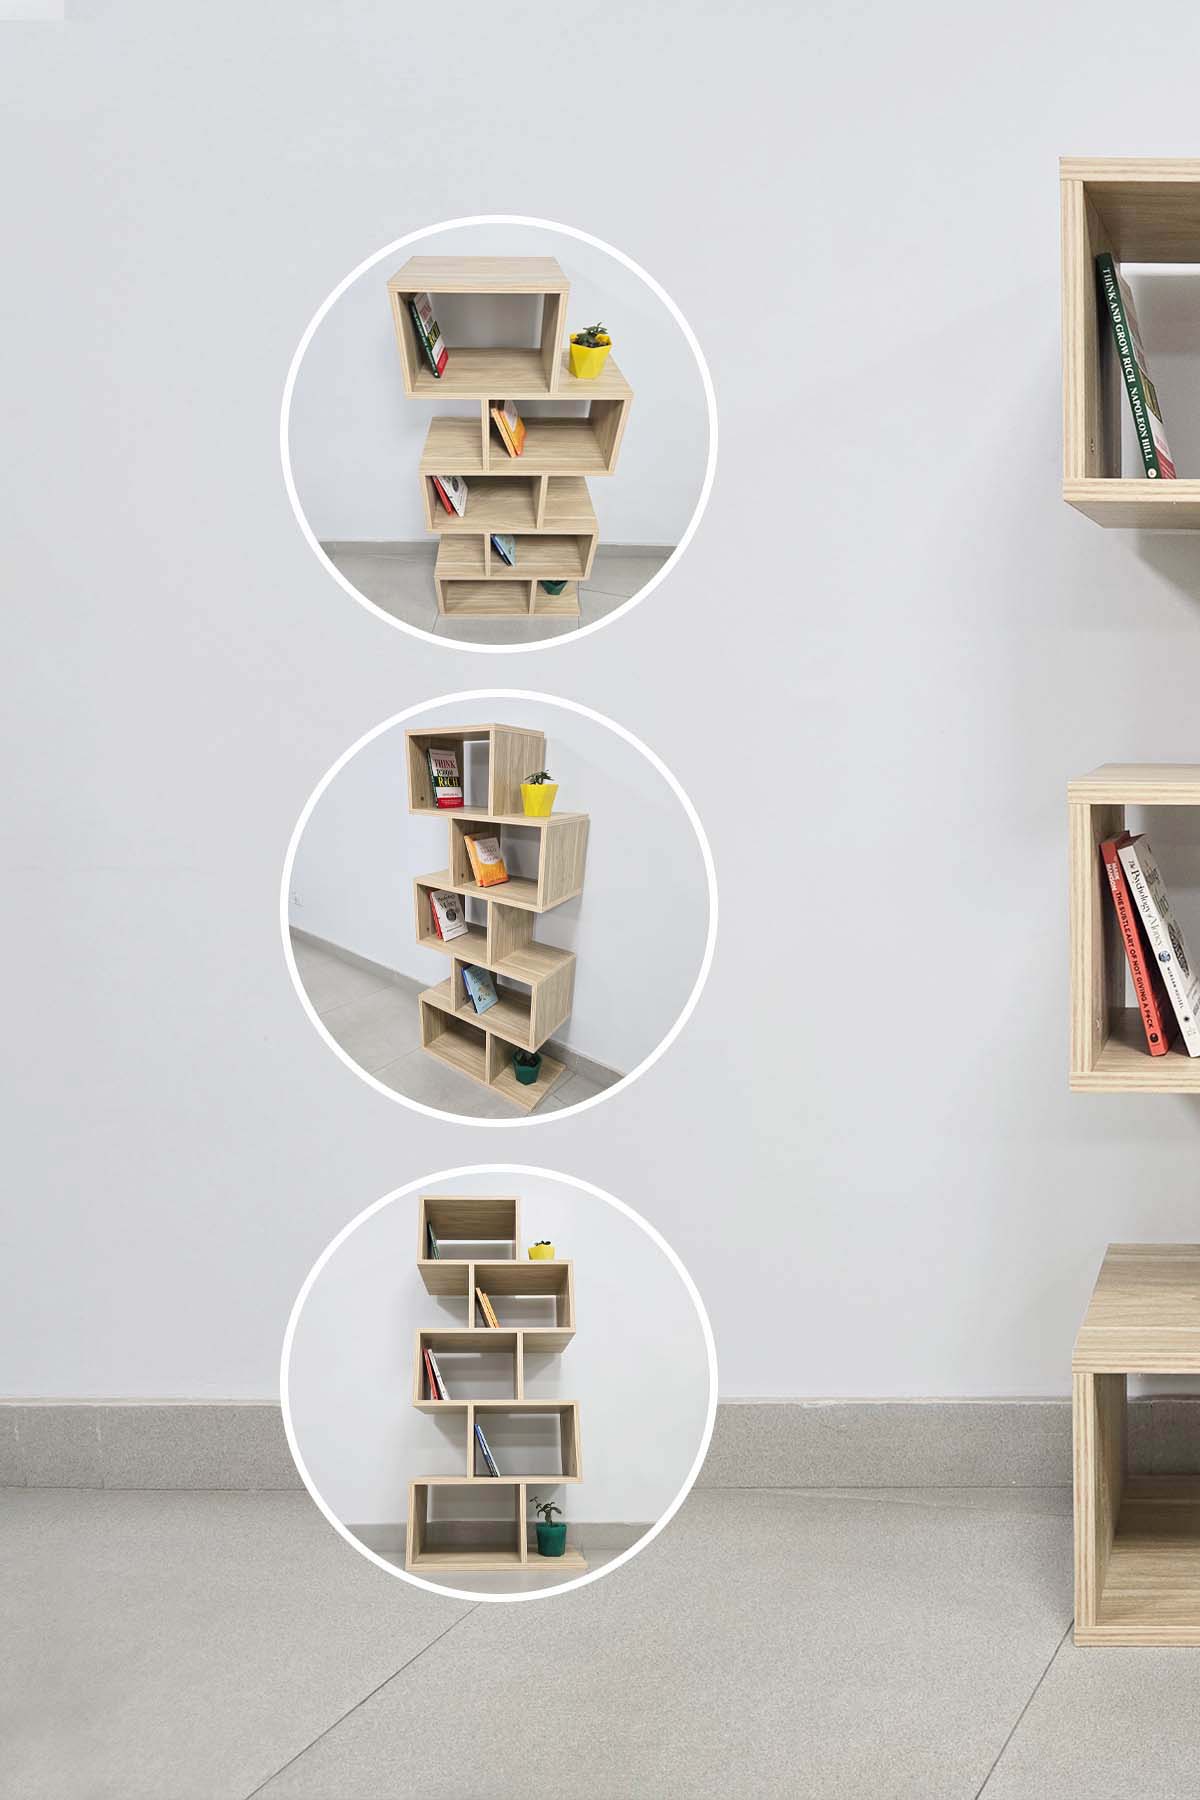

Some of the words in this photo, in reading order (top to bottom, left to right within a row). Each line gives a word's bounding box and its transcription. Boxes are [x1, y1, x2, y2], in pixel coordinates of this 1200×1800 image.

[1103, 268, 1116, 300] THINK
[1110, 301, 1121, 322] AND
[1115, 324, 1129, 356] GROW
[1123, 357, 1135, 383] RICH
[1130, 387, 1148, 438] NAPOLEON
[1142, 439, 1153, 461] HILL
[1130, 870, 1152, 913] Psychology
[1119, 907, 1130, 933] SUBTLE
[1126, 933, 1134, 947] ART
[1130, 949, 1137, 960] OF
[1136, 977, 1147, 1001] GIVING
